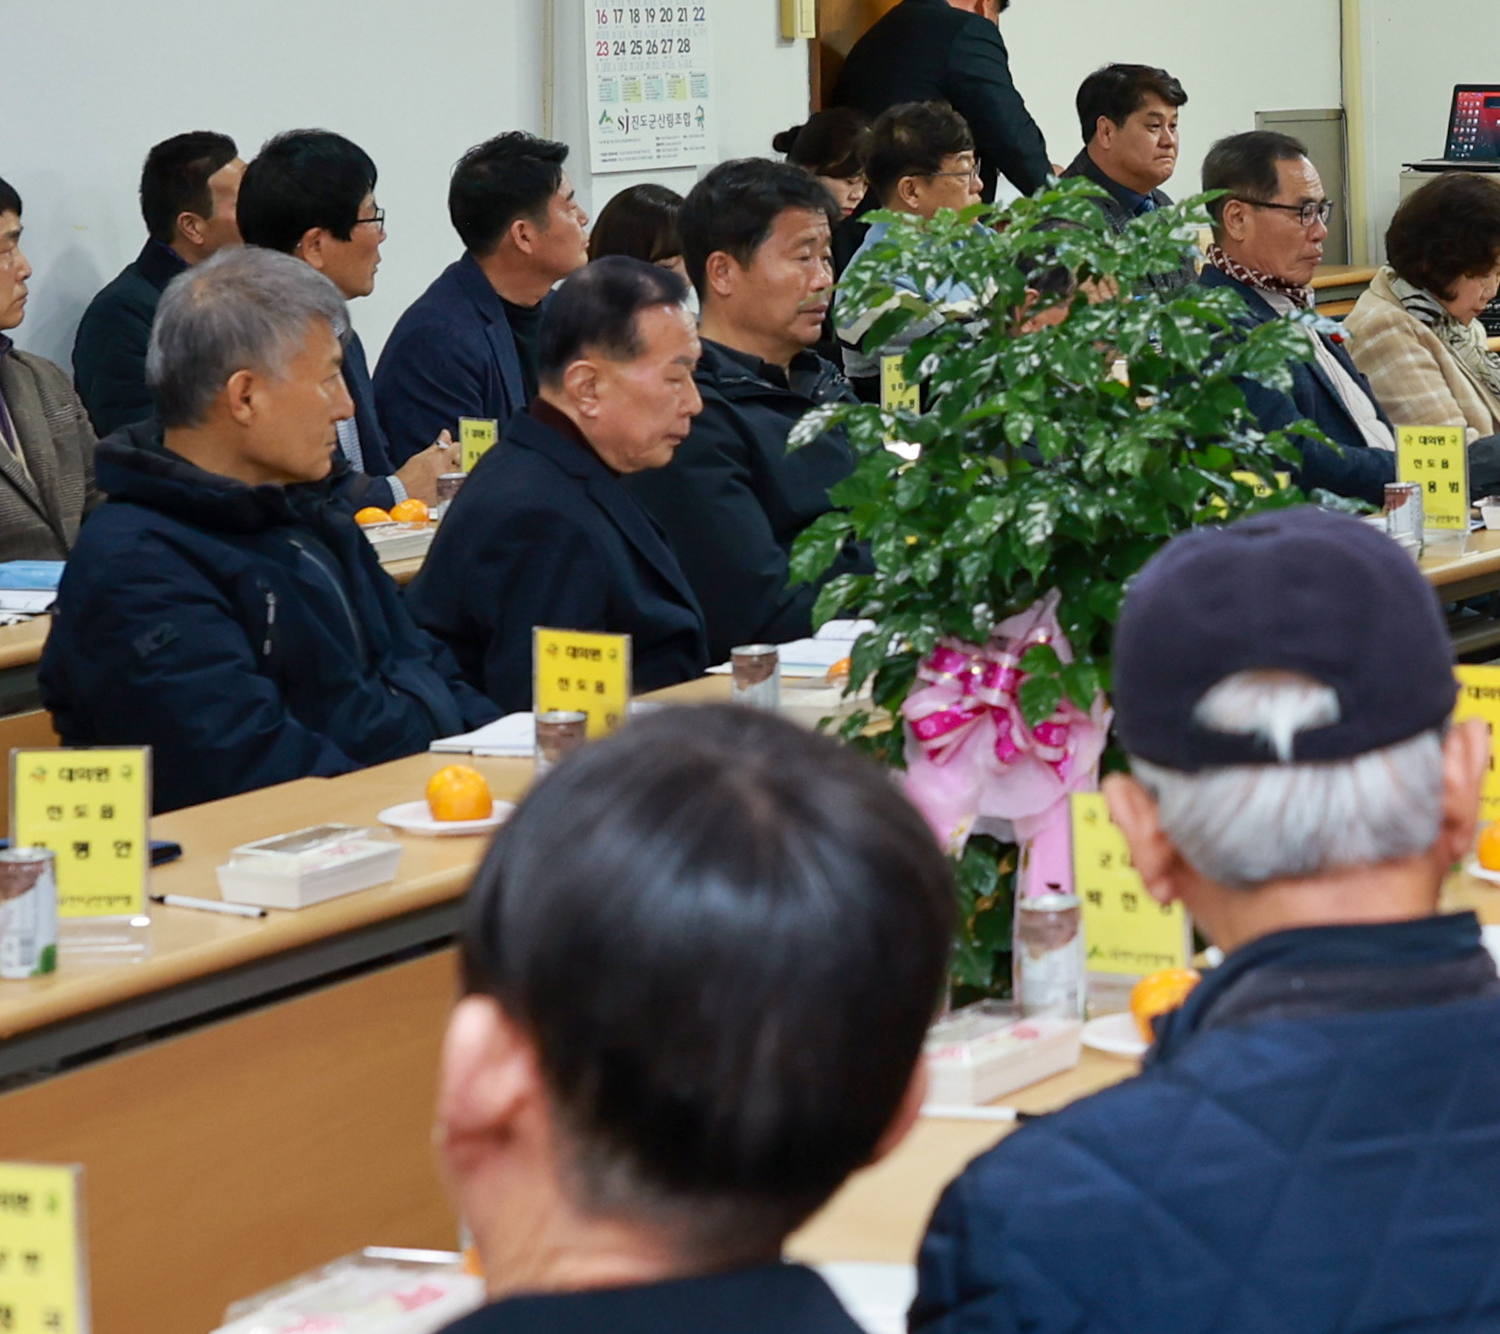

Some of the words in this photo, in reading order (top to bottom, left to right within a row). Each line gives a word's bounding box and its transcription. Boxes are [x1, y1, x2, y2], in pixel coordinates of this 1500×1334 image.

[596, 9, 608, 24] 16
[613, 9, 623, 24] 17
[629, 8, 640, 24] 18
[645, 8, 655, 23] 19
[660, 7, 673, 23] 20
[677, 7, 688, 22] 21
[693, 7, 705, 21] 22
[596, 41, 609, 57] 23
[613, 40, 626, 56] 24
[630, 40, 642, 55] 25
[646, 39, 658, 55] 26
[660, 38, 673, 54] 27
[677, 38, 691, 53] 28
[631, 112, 691, 130] 진도군산림조합
